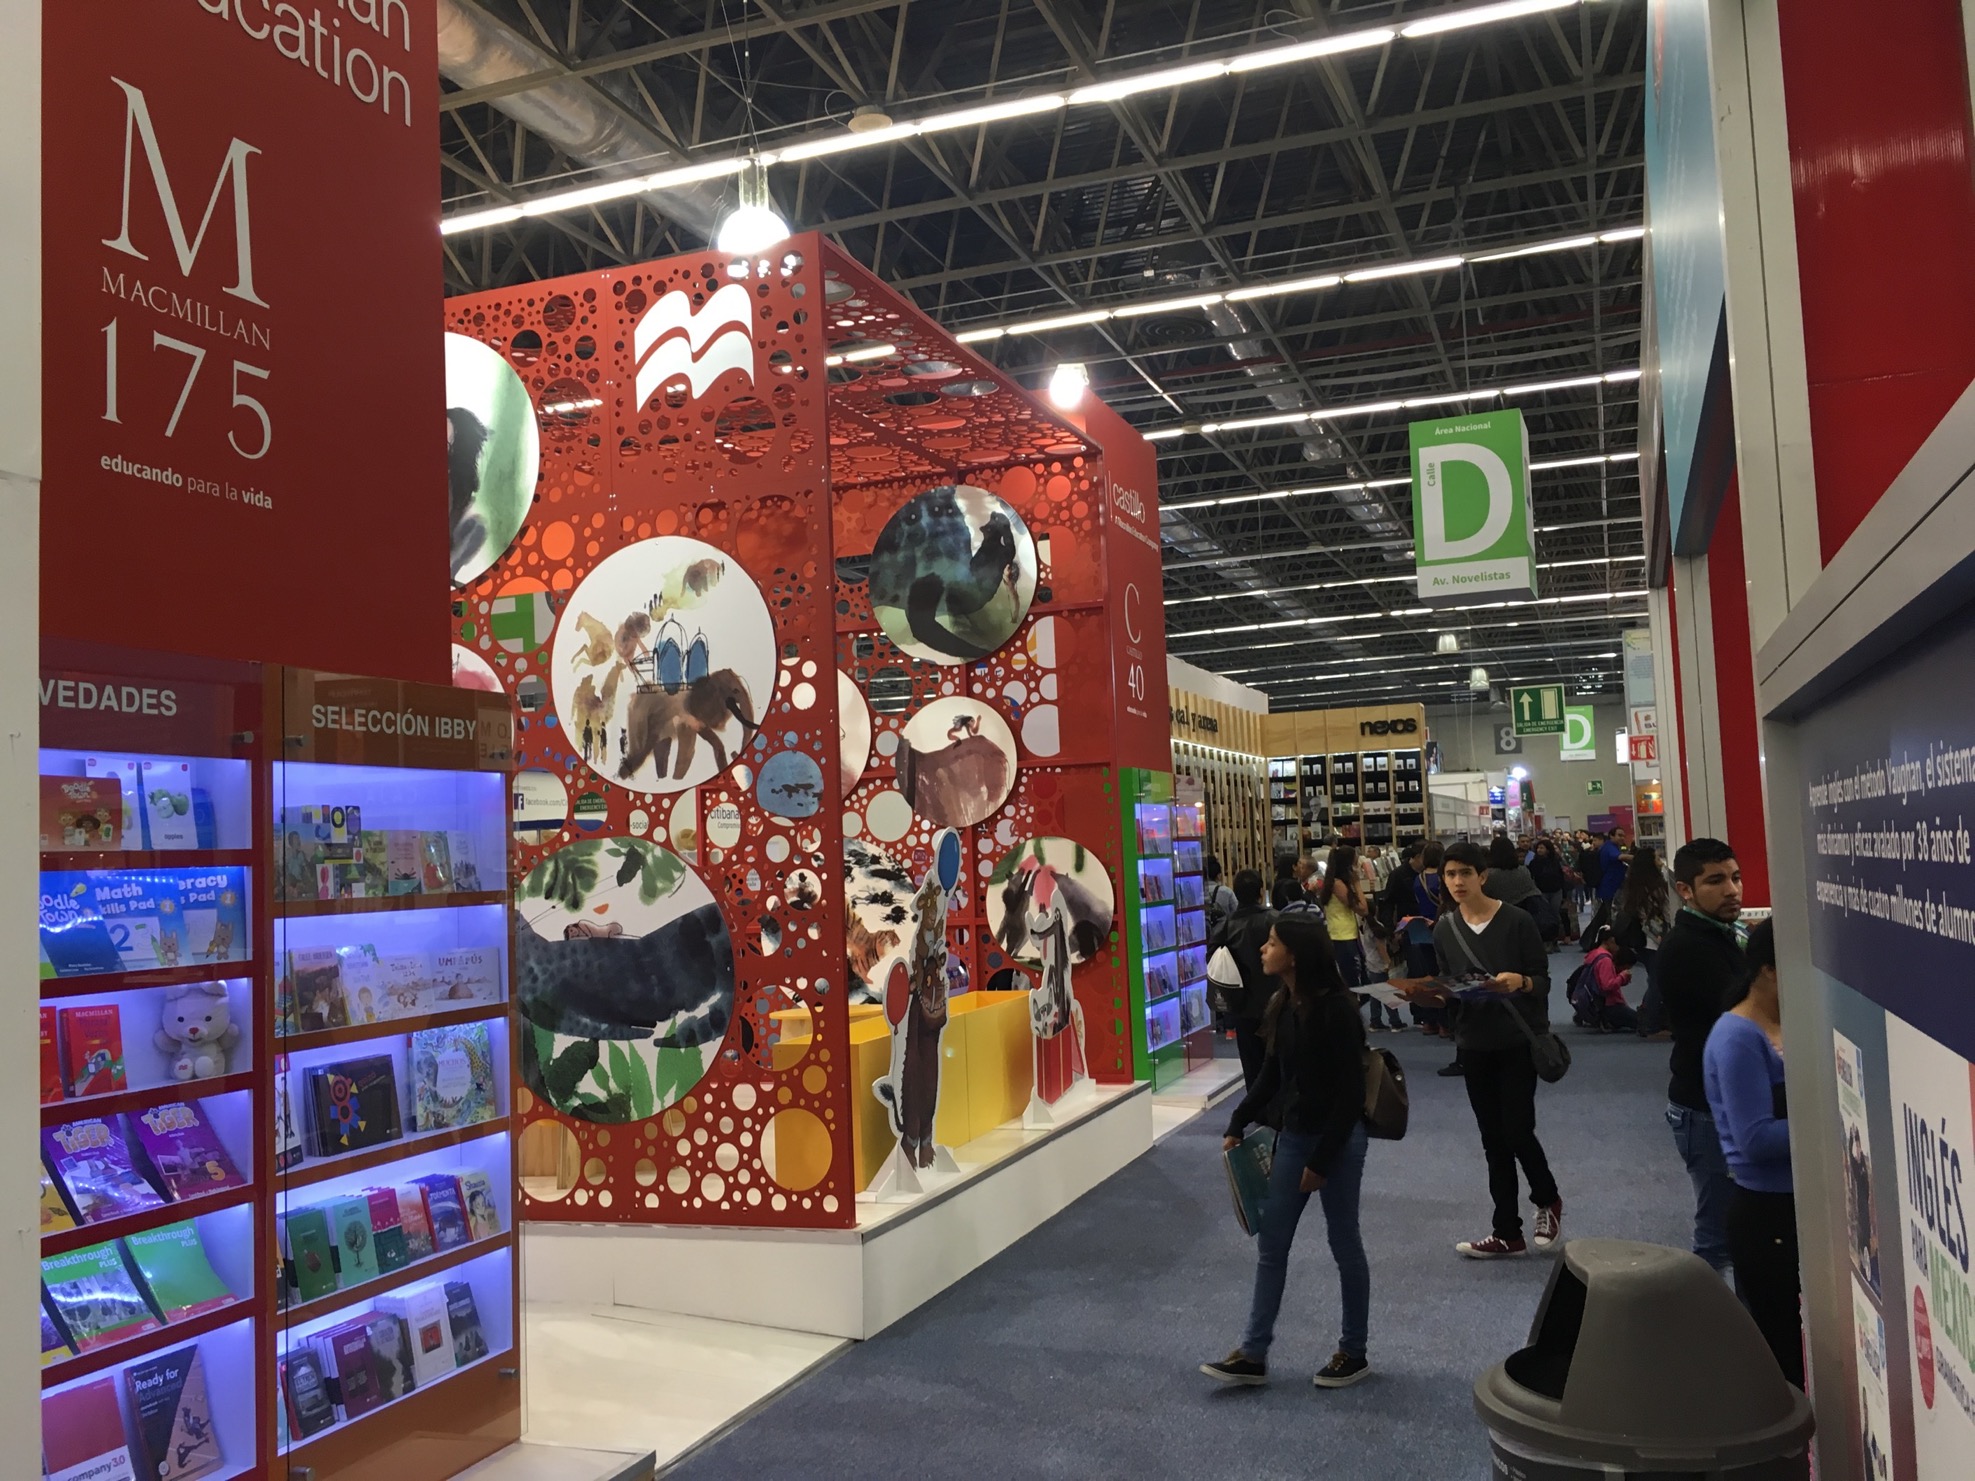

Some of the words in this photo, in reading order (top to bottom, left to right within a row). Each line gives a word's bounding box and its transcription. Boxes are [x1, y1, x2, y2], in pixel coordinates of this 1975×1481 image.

[101, 75, 270, 309] M
[101, 266, 271, 351] MACMILLAN
[101, 316, 273, 460] 175
[1434, 426, 1454, 436] Área
[1455, 421, 1491, 433] Nacional
[100, 454, 183, 488] educando
[187, 474, 220, 498] para
[225, 482, 239, 502] la
[242, 488, 273, 510] vida
[1427, 462, 1436, 487] Calle
[1418, 442, 1513, 562] D
[1432, 577, 1450, 586] Av.
[1452, 571, 1511, 584] Novelistas
[1124, 582, 1142, 644] C
[1128, 663, 1145, 701] 40
[311, 703, 430, 737] SELECCIÓN
[435, 717, 477, 740] IBBY
[1360, 717, 1418, 737] nexos
[1500, 726, 1517, 751] 8
[1861, 758, 1886, 799] método
[1886, 751, 1925, 806] Vaughan,
[1926, 743, 1936, 790] el
[1873, 819, 1901, 860] avalado
[1902, 833, 1916, 871] por
[1917, 820, 1929, 862] 38
[1930, 815, 1955, 863] años
[1956, 814, 1972, 865] de
[94, 882, 143, 901] Math
[129, 897, 155, 911] Pad
[189, 890, 216, 903] Pad
[1868, 887, 1890, 921] cuatro
[1890, 884, 1924, 931] millones
[1925, 888, 1938, 935] de
[75, 1009, 113, 1018] MACMILLAN
[206, 1160, 225, 1181] 5
[1902, 1102, 1969, 1275] INGLÉS
[131, 1225, 194, 1246] Breakthrough
[181, 1238, 197, 1247] PLUS
[40, 1246, 113, 1271] Breakthrough
[99, 1258, 117, 1268] PLUS
[135, 1373, 164, 1393] Ready
[165, 1368, 179, 1380] for
[111, 1454, 126, 1467] 3.0
